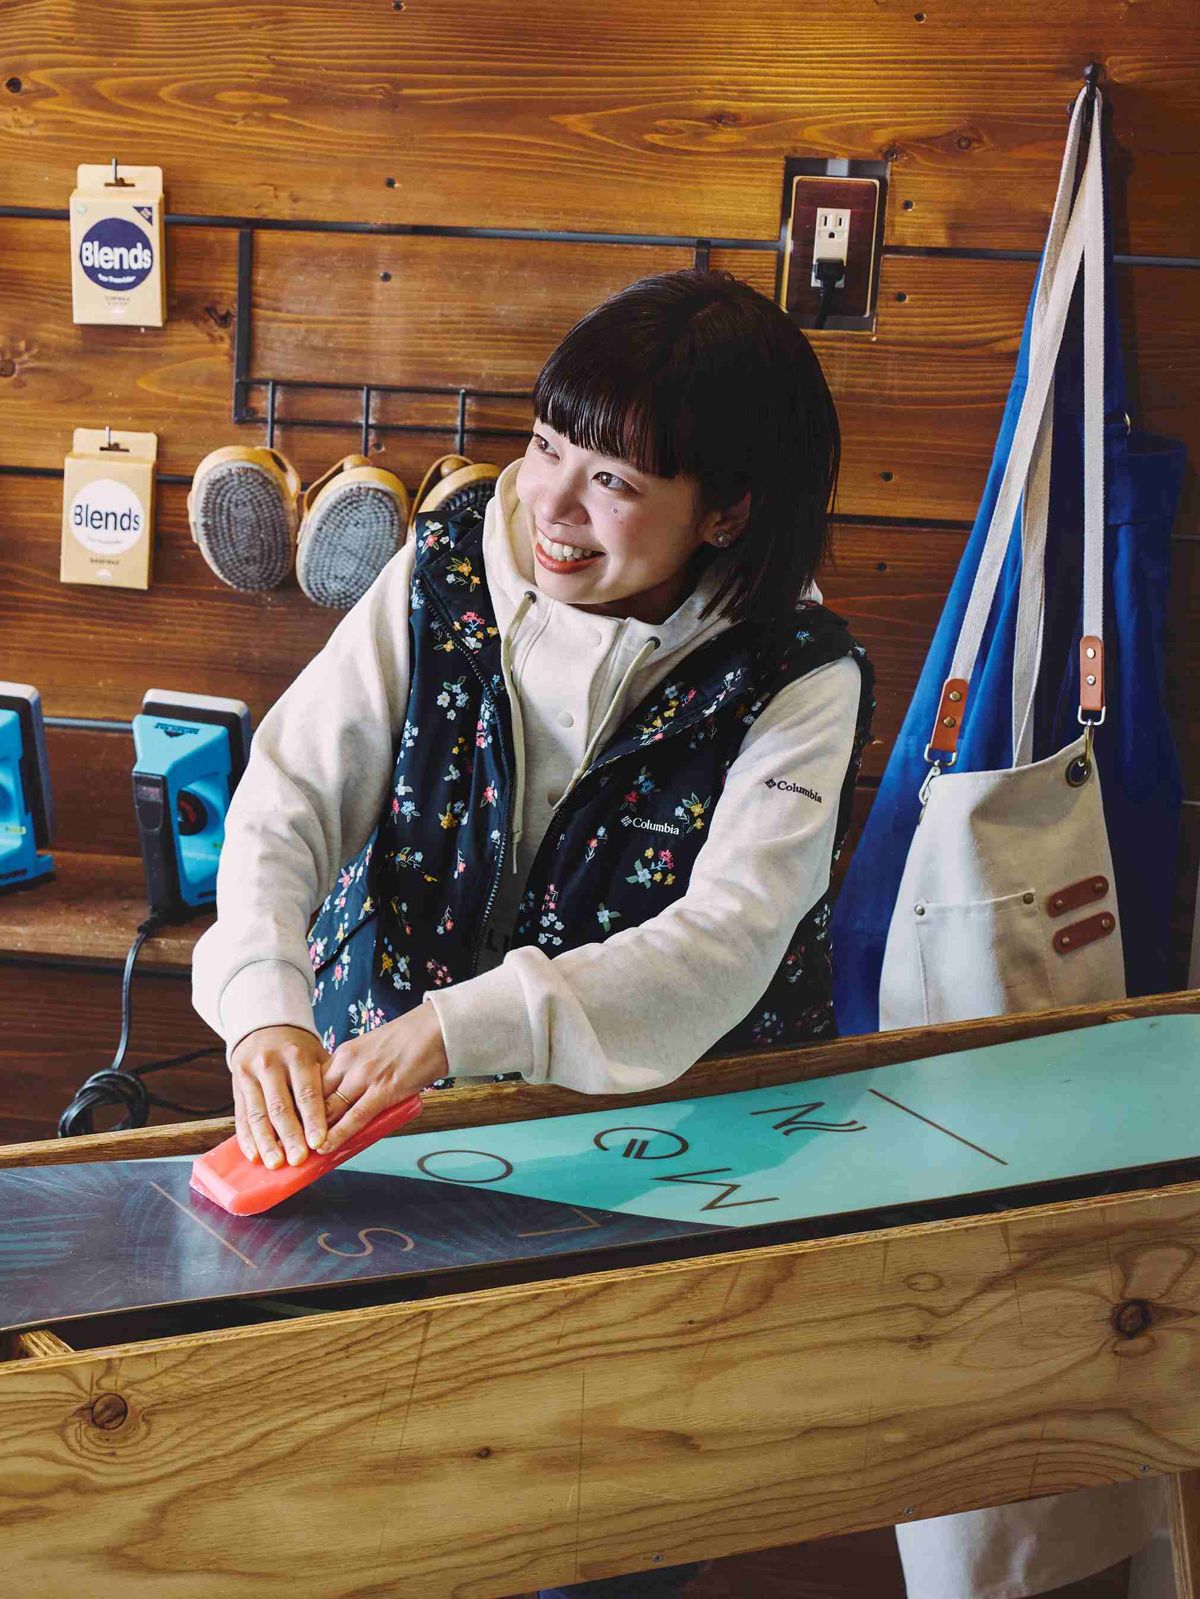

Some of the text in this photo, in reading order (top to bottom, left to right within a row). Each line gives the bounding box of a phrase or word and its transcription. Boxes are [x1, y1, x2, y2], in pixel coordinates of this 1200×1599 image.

[81, 241, 152, 270] Blends
[74, 503, 140, 531] Blends
[776, 780, 823, 804] Columbia
[632, 817, 680, 836] Columbia
